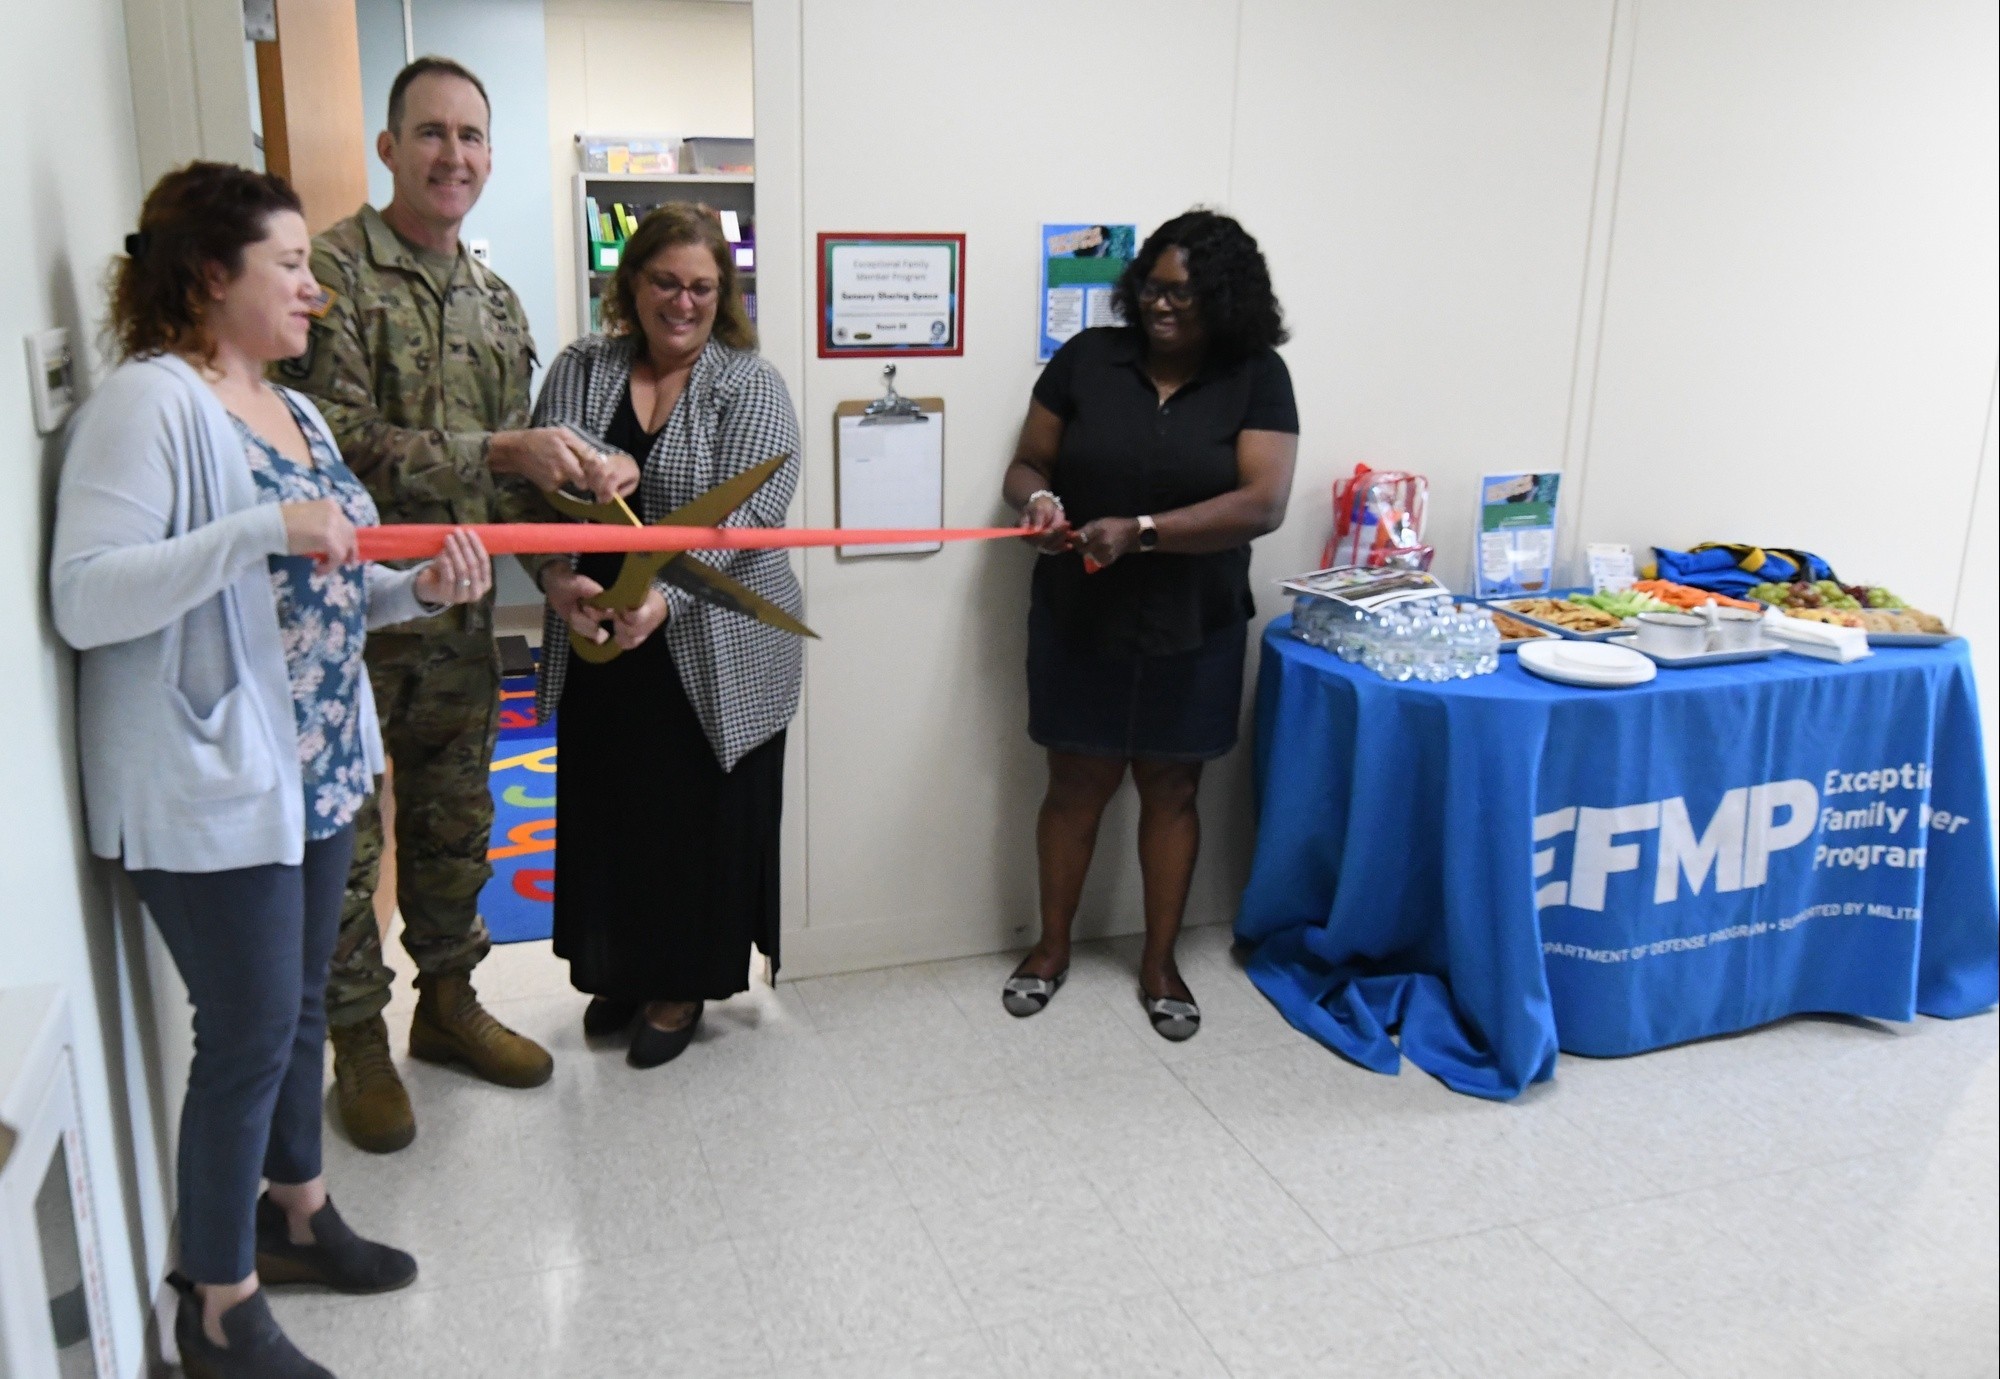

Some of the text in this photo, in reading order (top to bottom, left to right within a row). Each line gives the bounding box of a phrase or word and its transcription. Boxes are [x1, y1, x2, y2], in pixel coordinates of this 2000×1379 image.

[902, 260, 929, 270] Family
[891, 272, 926, 282] Program
[841, 291, 874, 301] Sensory
[912, 291, 938, 301] Space
[1818, 801, 1909, 834] Family
[1533, 778, 1820, 913] EFMP
[1542, 942, 1630, 963] PARTMENT
[1630, 944, 1649, 960] OF
[1649, 934, 1708, 956] DEFENSE
[1842, 901, 1865, 916] BY
